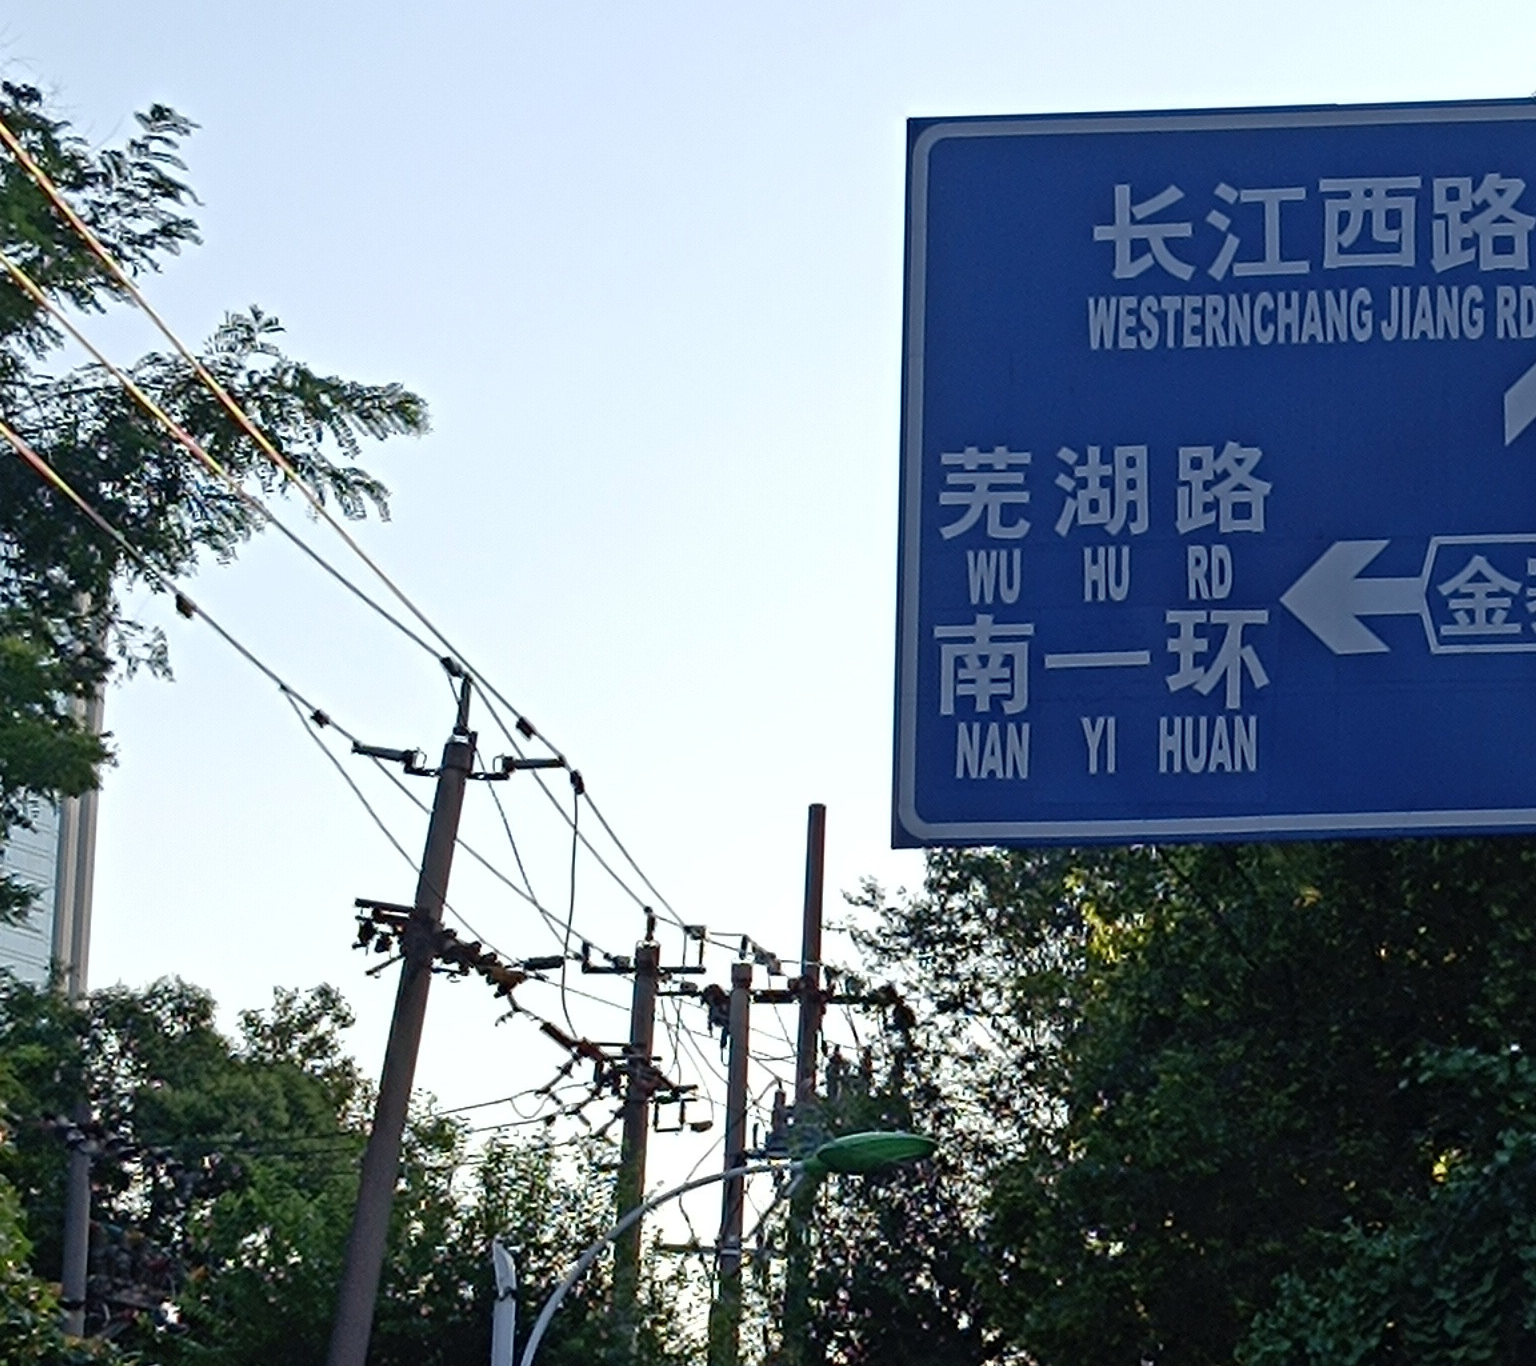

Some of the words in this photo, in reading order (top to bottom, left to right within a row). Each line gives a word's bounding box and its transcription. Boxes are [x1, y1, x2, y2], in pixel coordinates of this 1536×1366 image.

[938, 440, 1273, 541] 芜湖路
[967, 548, 1022, 605] WU
[1083, 545, 1131, 602] HU
[1187, 544, 1233, 600] RD
[933, 608, 1271, 717] 南一环
[955, 721, 1031, 780] NAN
[1081, 715, 1117, 775] YI
[1158, 714, 1258, 774] HUAN
